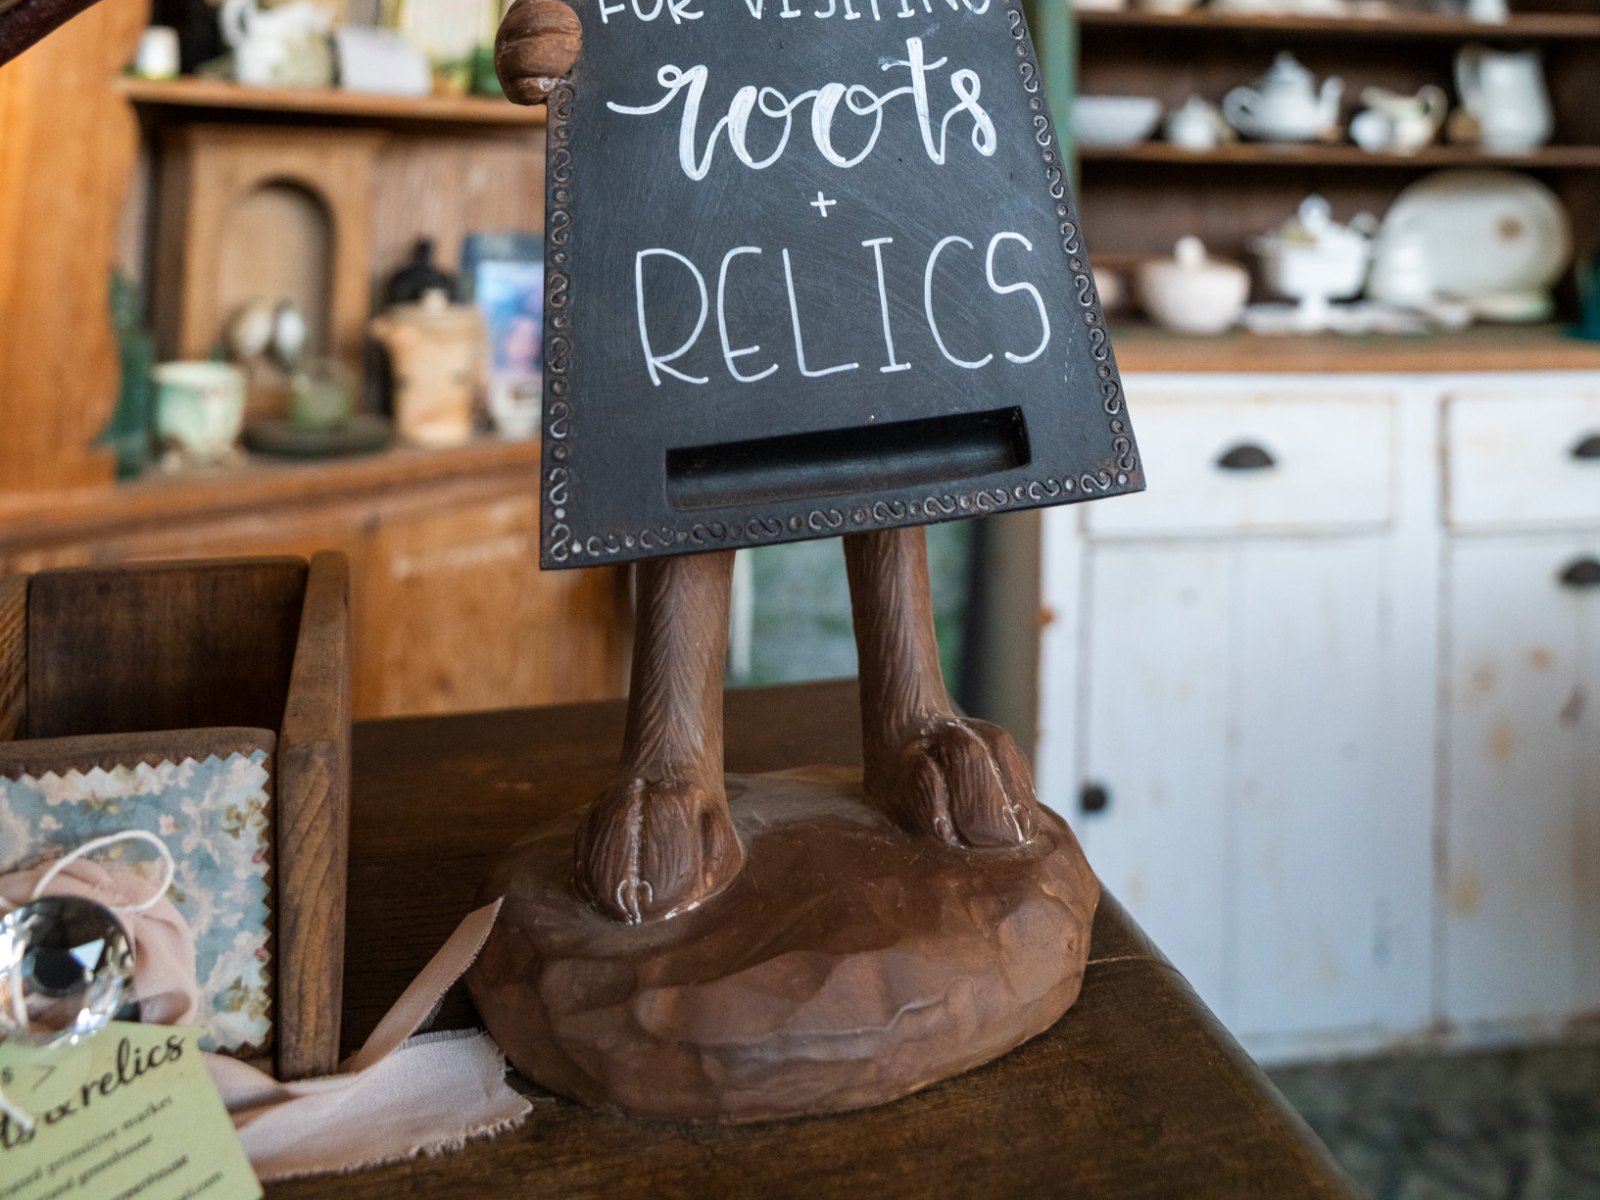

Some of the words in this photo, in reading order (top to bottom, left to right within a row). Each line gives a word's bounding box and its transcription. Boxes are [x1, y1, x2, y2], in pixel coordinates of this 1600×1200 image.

[607, 37, 997, 181] roots
[636, 231, 1052, 386] RELICS
[82, 1034, 186, 1107] relics
